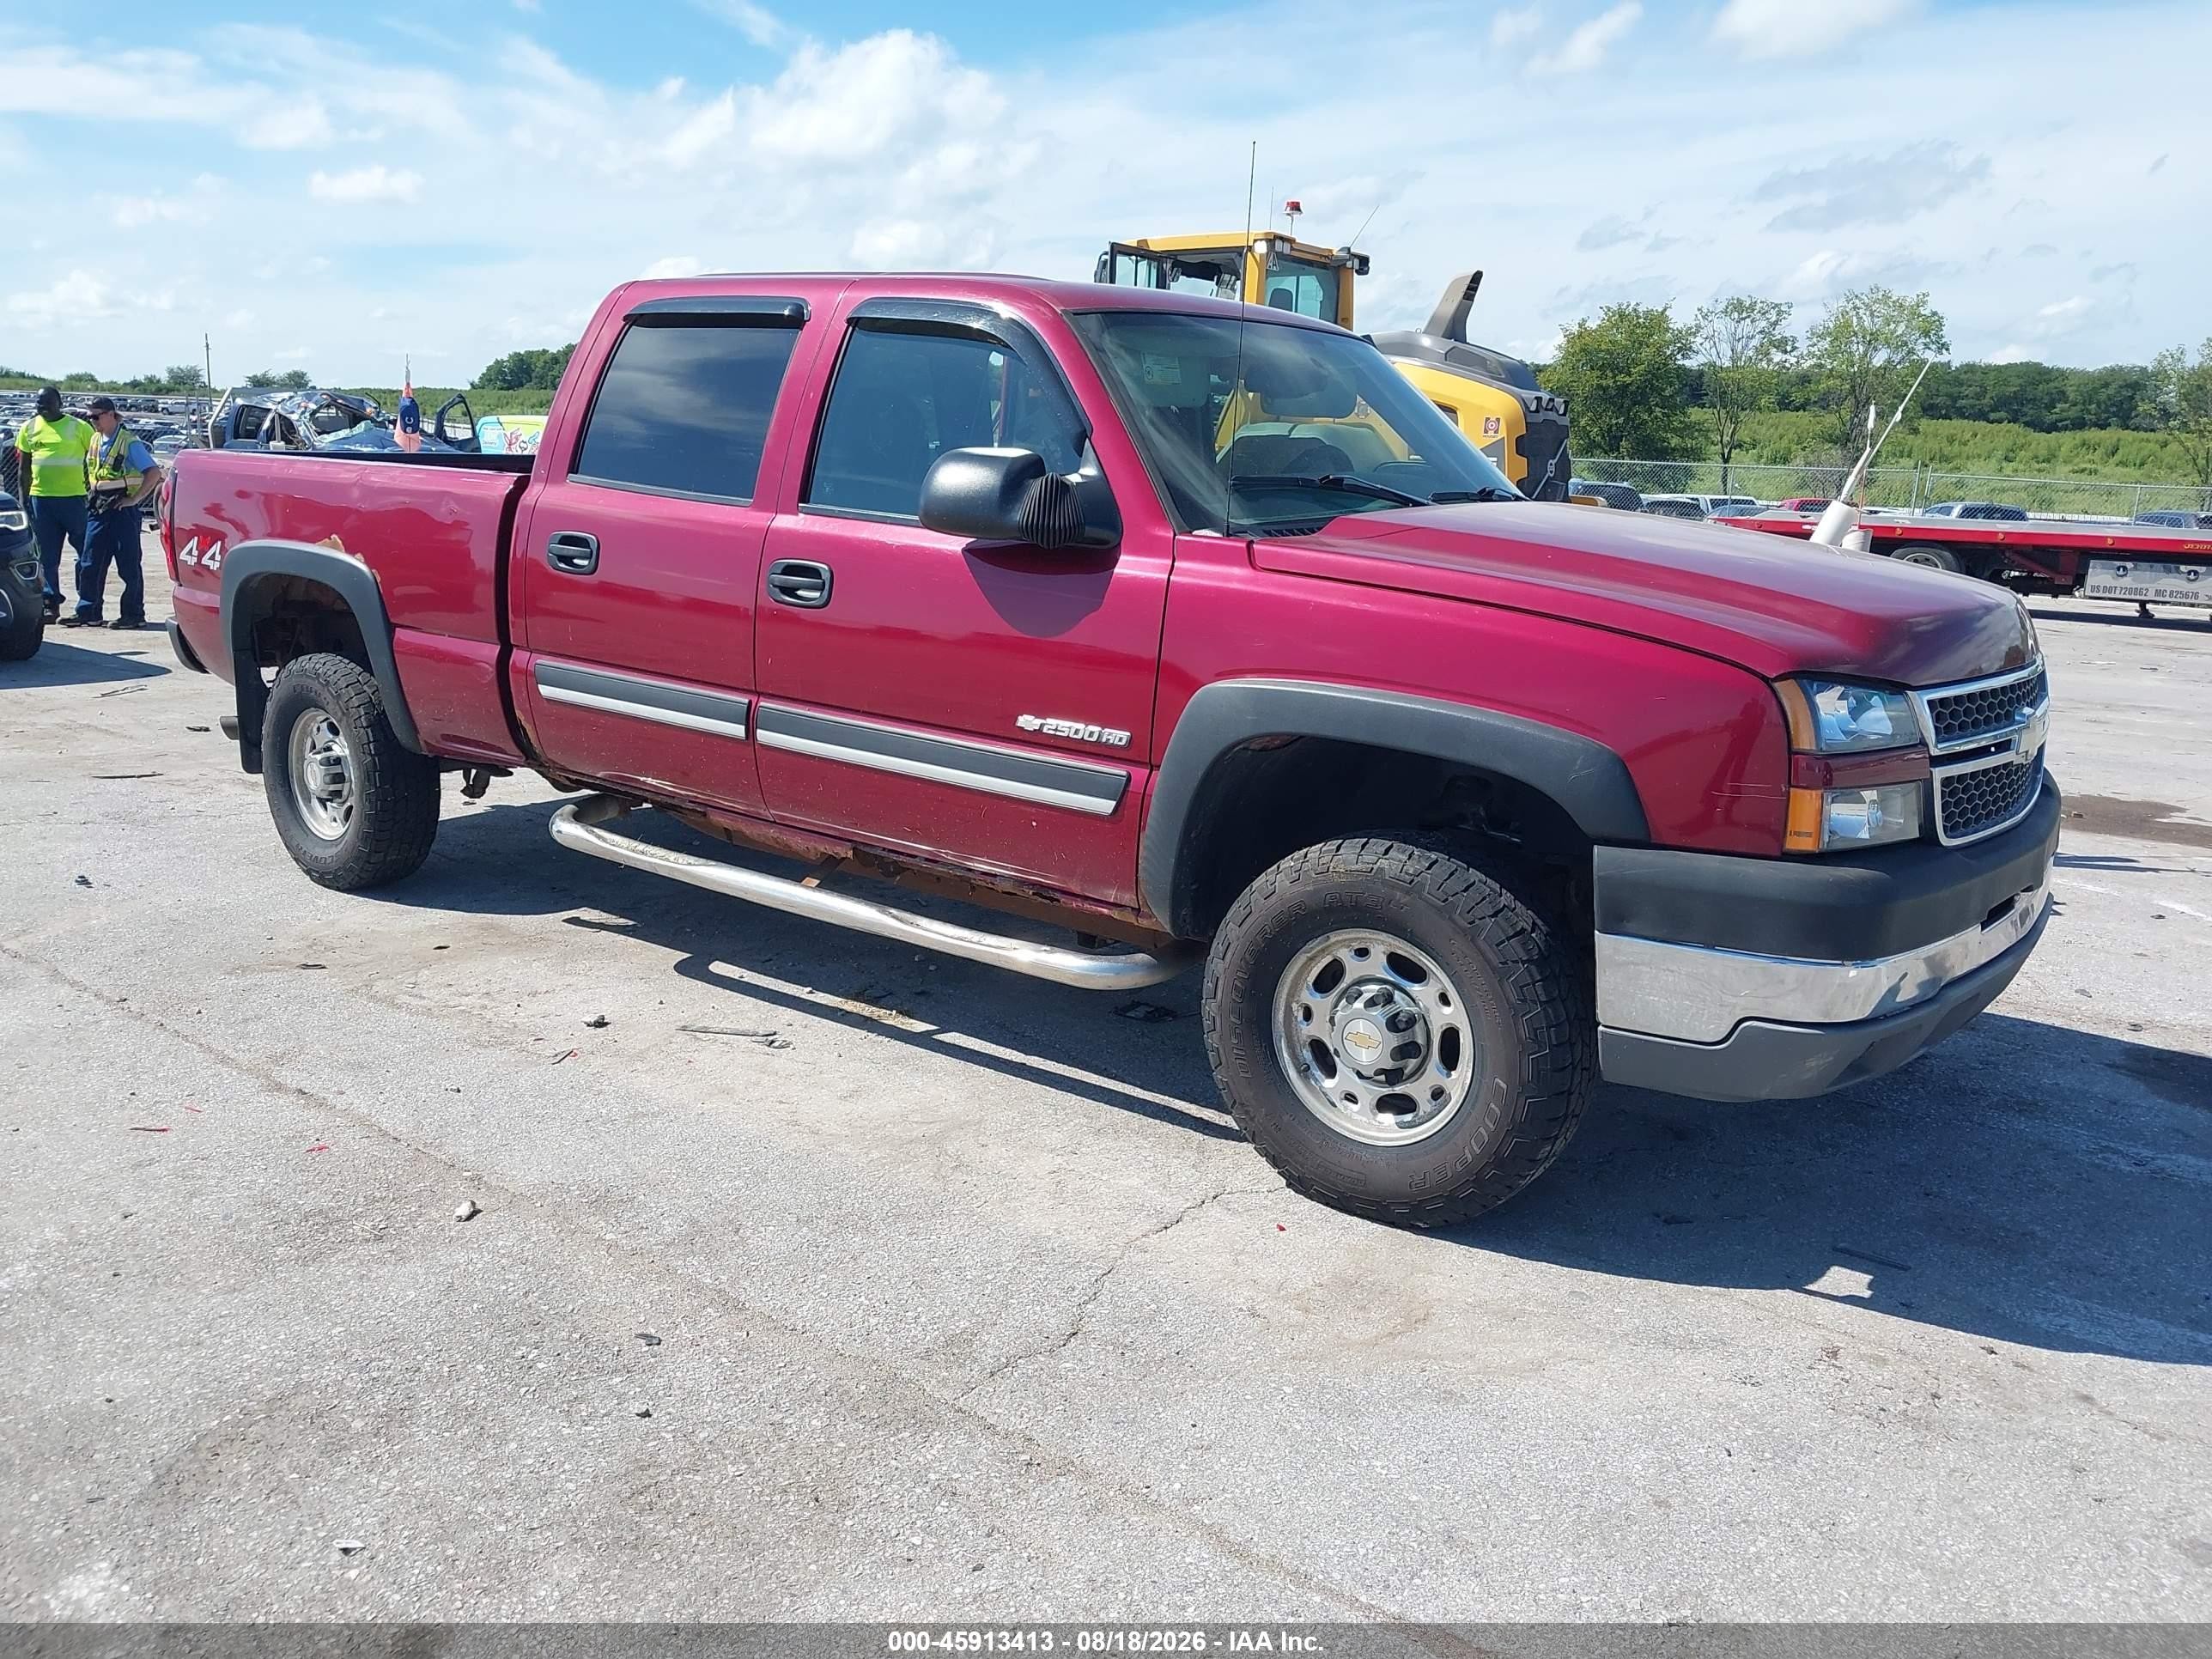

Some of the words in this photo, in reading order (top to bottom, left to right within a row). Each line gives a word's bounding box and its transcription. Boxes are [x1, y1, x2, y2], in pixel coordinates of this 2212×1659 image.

[2090, 585, 2100, 594] US
[2102, 585, 2118, 595] DOT
[2118, 586, 2149, 597] 720862
[2154, 588, 2167, 599] MC
[2168, 590, 2200, 601] 825676
[1229, 899, 1308, 1079] DISCOVERER
[1408, 1076, 1508, 1191] COOPER
